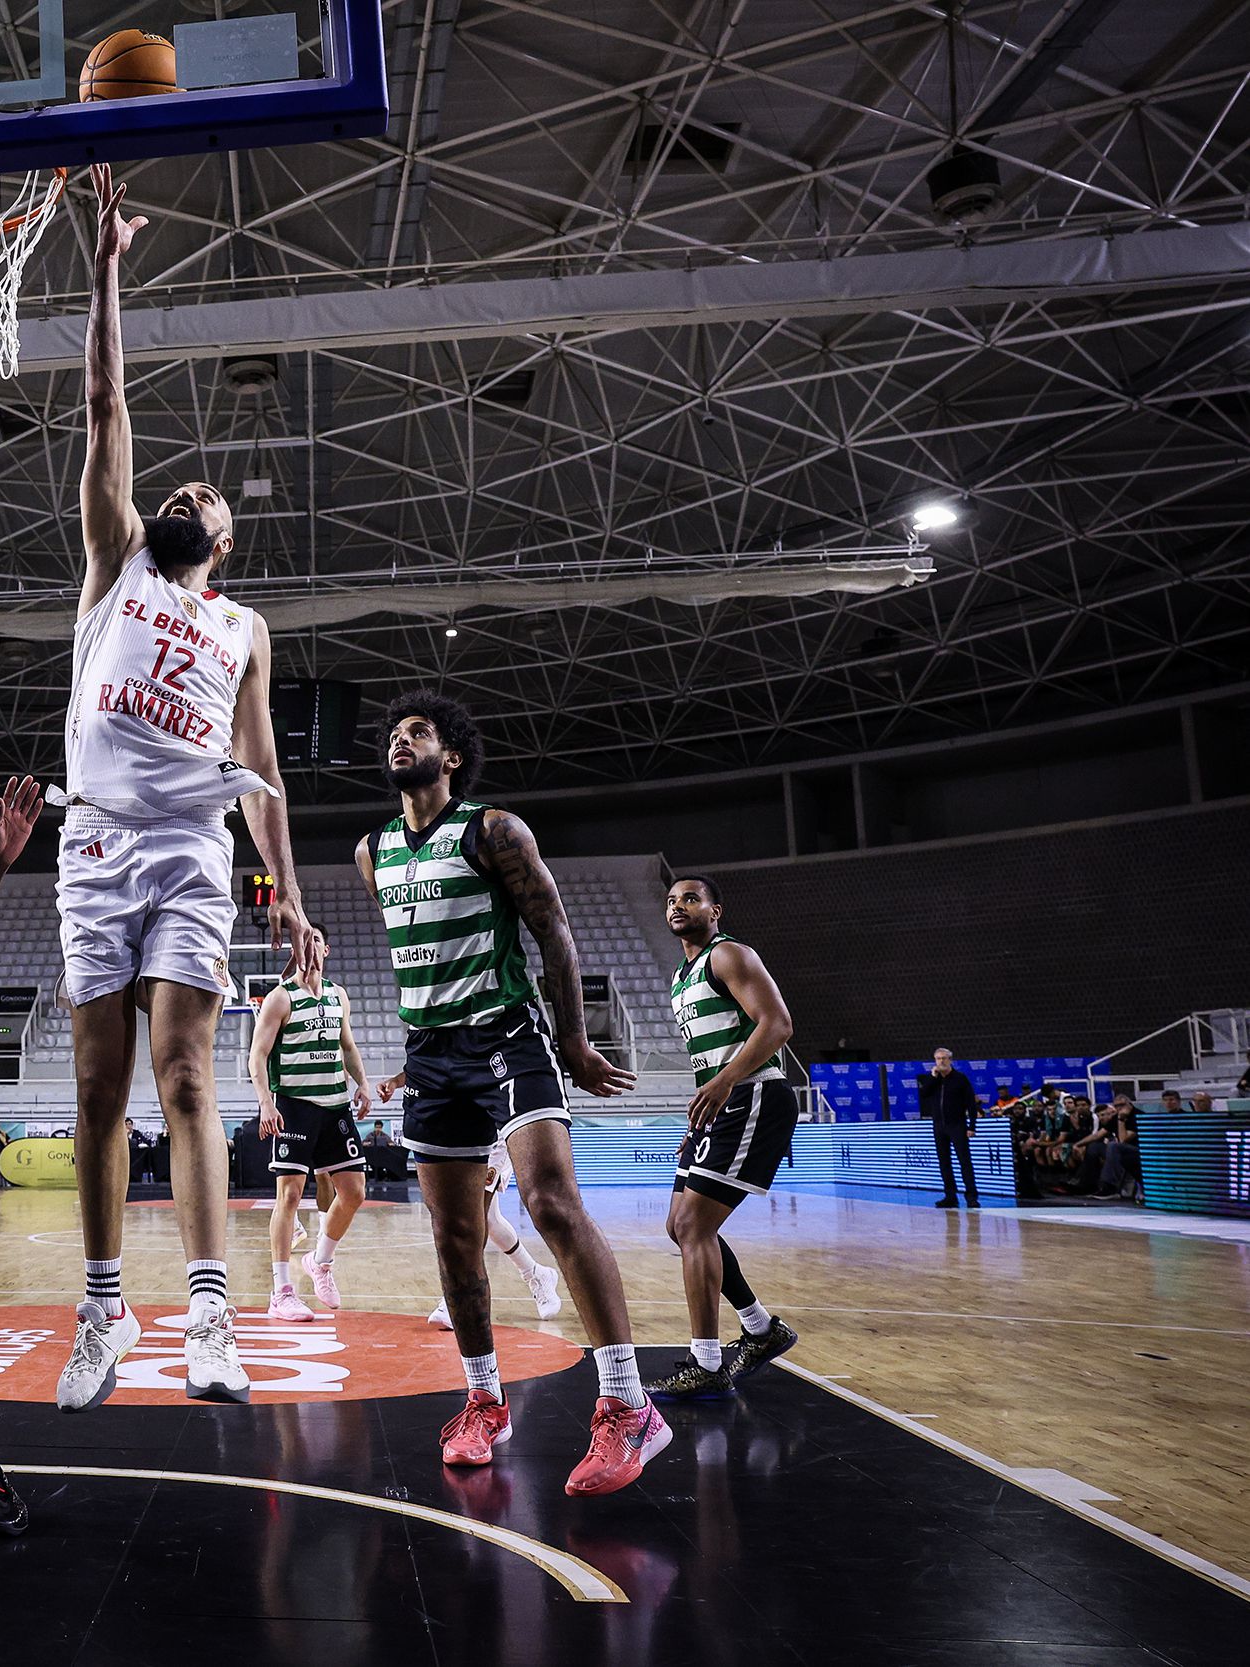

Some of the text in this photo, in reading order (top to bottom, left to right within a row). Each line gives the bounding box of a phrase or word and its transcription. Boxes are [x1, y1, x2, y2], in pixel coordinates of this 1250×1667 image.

[122, 599, 238, 681] SL BENFICA
[150, 638, 195, 693] 12
[97, 684, 214, 749] RAMIREZ
[382, 880, 442, 906] SPORTING
[402, 905, 417, 942] 7
[304, 1017, 340, 1031] SPORTING
[318, 1030, 327, 1049] 6
[500, 1078, 517, 1117] 7
[346, 1137, 359, 1158] 6
